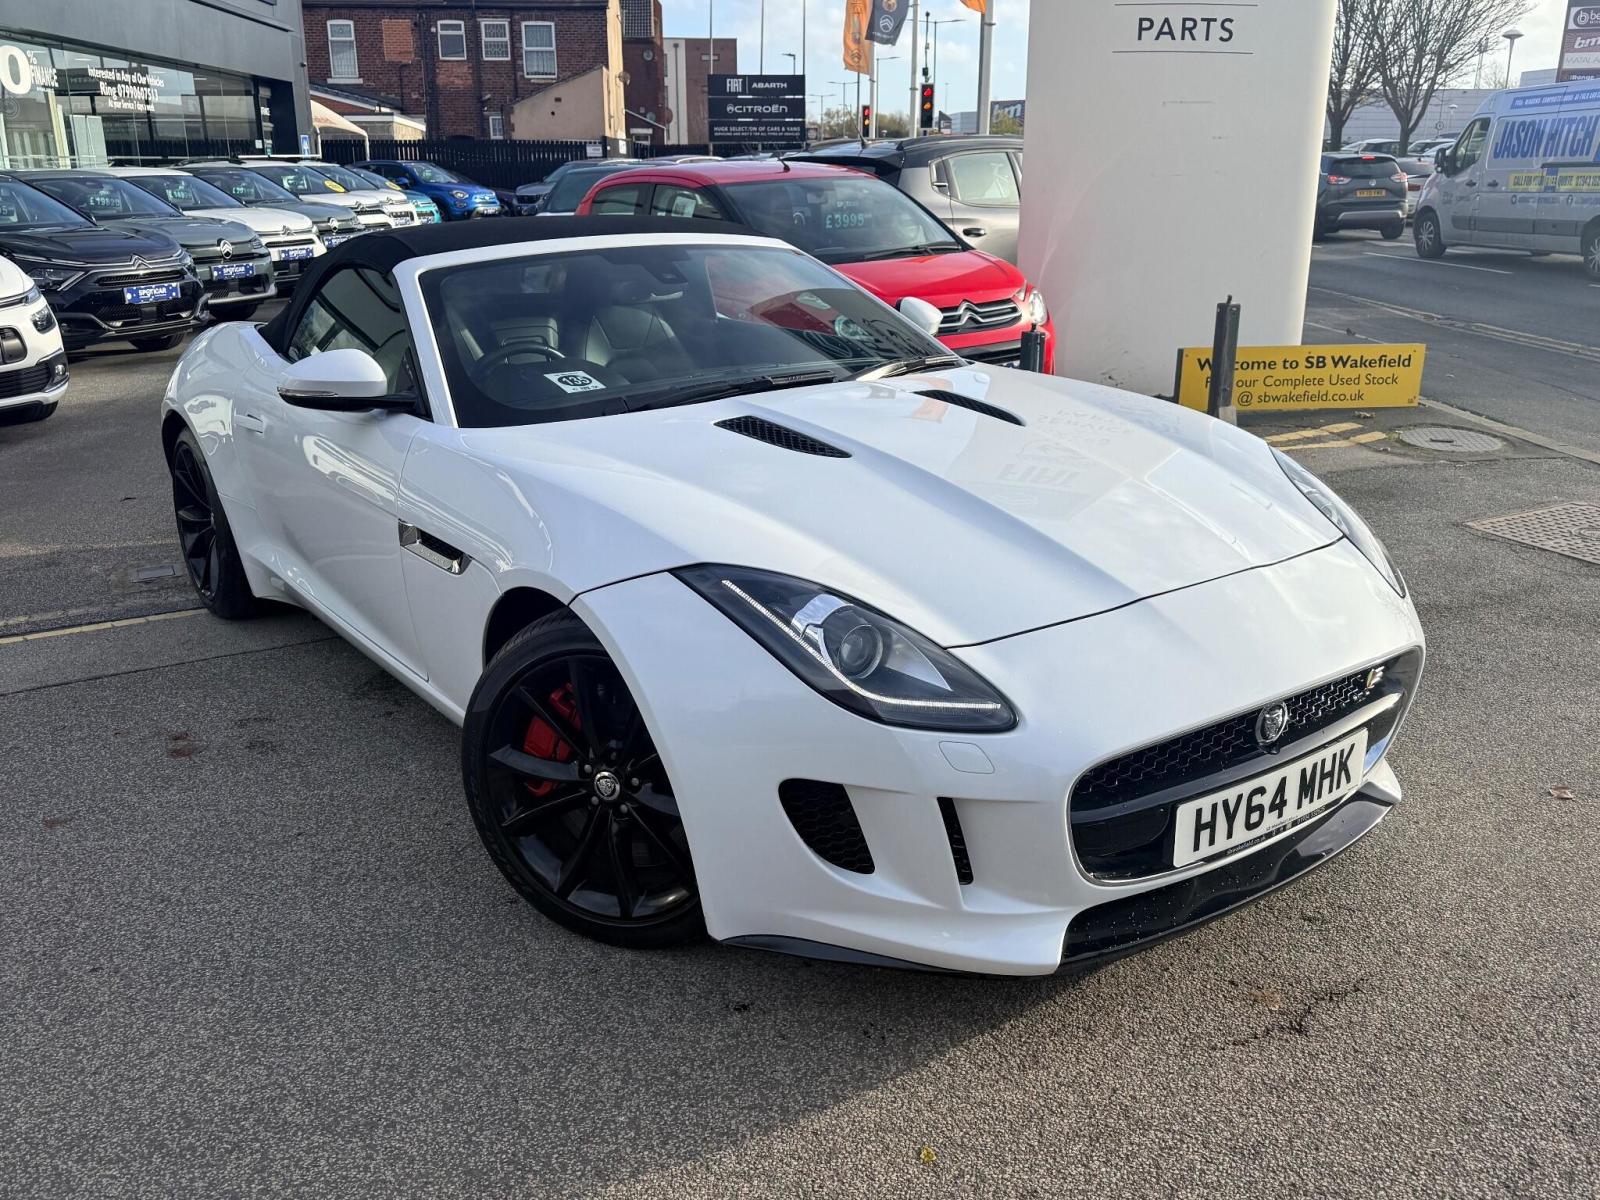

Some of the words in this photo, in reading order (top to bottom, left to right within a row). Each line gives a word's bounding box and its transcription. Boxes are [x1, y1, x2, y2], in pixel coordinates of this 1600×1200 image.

[1137, 17, 1234, 42] PARTS
[30, 64, 59, 88] FINANCE
[88, 64, 115, 81] Interested
[116, 69, 122, 81] in
[121, 70, 131, 85] Any
[132, 72, 137, 83] of
[137, 72, 147, 84] Our
[146, 74, 164, 87] Vehicles
[100, 81, 117, 100] Ring
[727, 79, 743, 92] FIAT
[1493, 118, 1548, 159] JASON
[1542, 115, 1599, 158] HITCH
[826, 213, 865, 229] £3995
[223, 267, 245, 275] SPOTICAR
[139, 287, 167, 297] SPOTICAR
[1197, 357, 1276, 371] Wome
[1282, 358, 1299, 369] to
[1305, 355, 1326, 369] SB
[1331, 354, 1412, 369] Wakefield
[1263, 375, 1325, 390] Complete
[1329, 373, 1360, 386] Used
[1364, 372, 1399, 385] Stock
[1237, 390, 1253, 407] @
[1257, 390, 1364, 404] sbwakefield.co.uk
[1193, 775, 1287, 853] HY64
[1297, 742, 1355, 811] MHK
